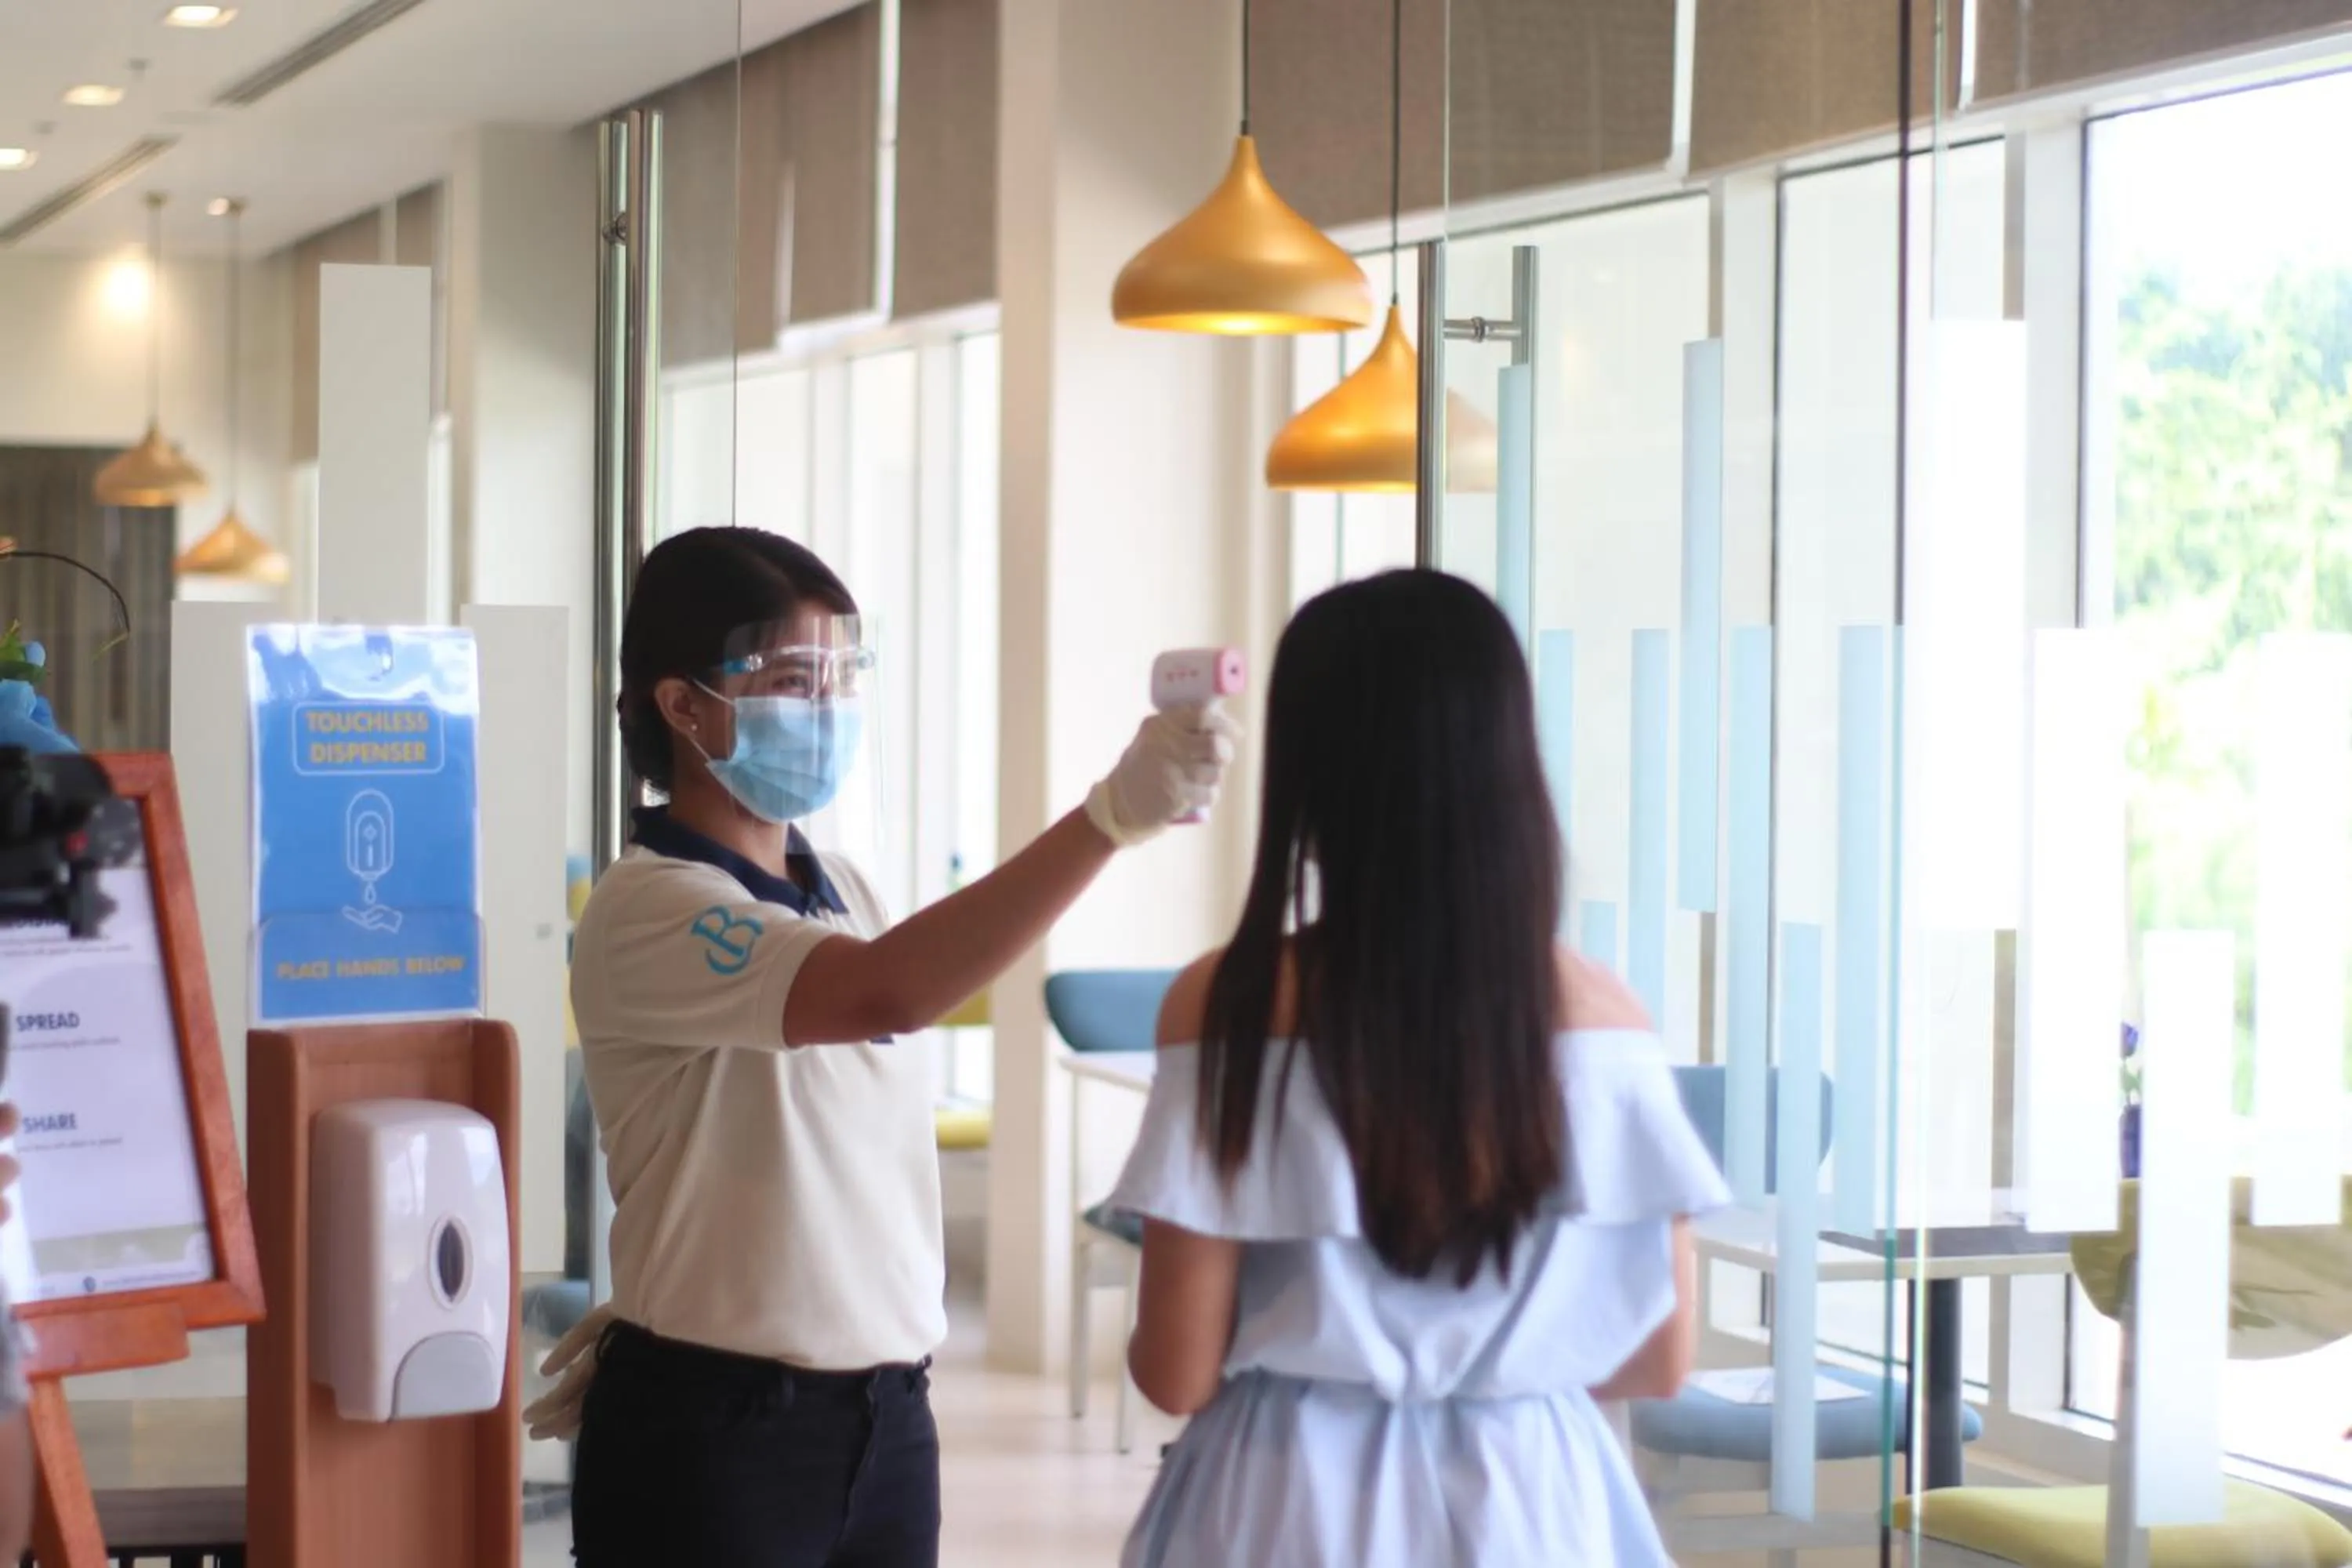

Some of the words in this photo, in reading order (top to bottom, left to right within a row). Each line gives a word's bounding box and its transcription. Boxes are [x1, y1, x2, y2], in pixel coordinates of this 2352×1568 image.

[307, 711, 429, 733] TOUCHLESS
[310, 741, 426, 764] DISPENSER
[277, 960, 329, 980] PLACE
[337, 957, 399, 977] HANDS
[405, 955, 465, 975] BELOW
[16, 1010, 80, 1033] SPREAD
[23, 1112, 78, 1134] SHARE
